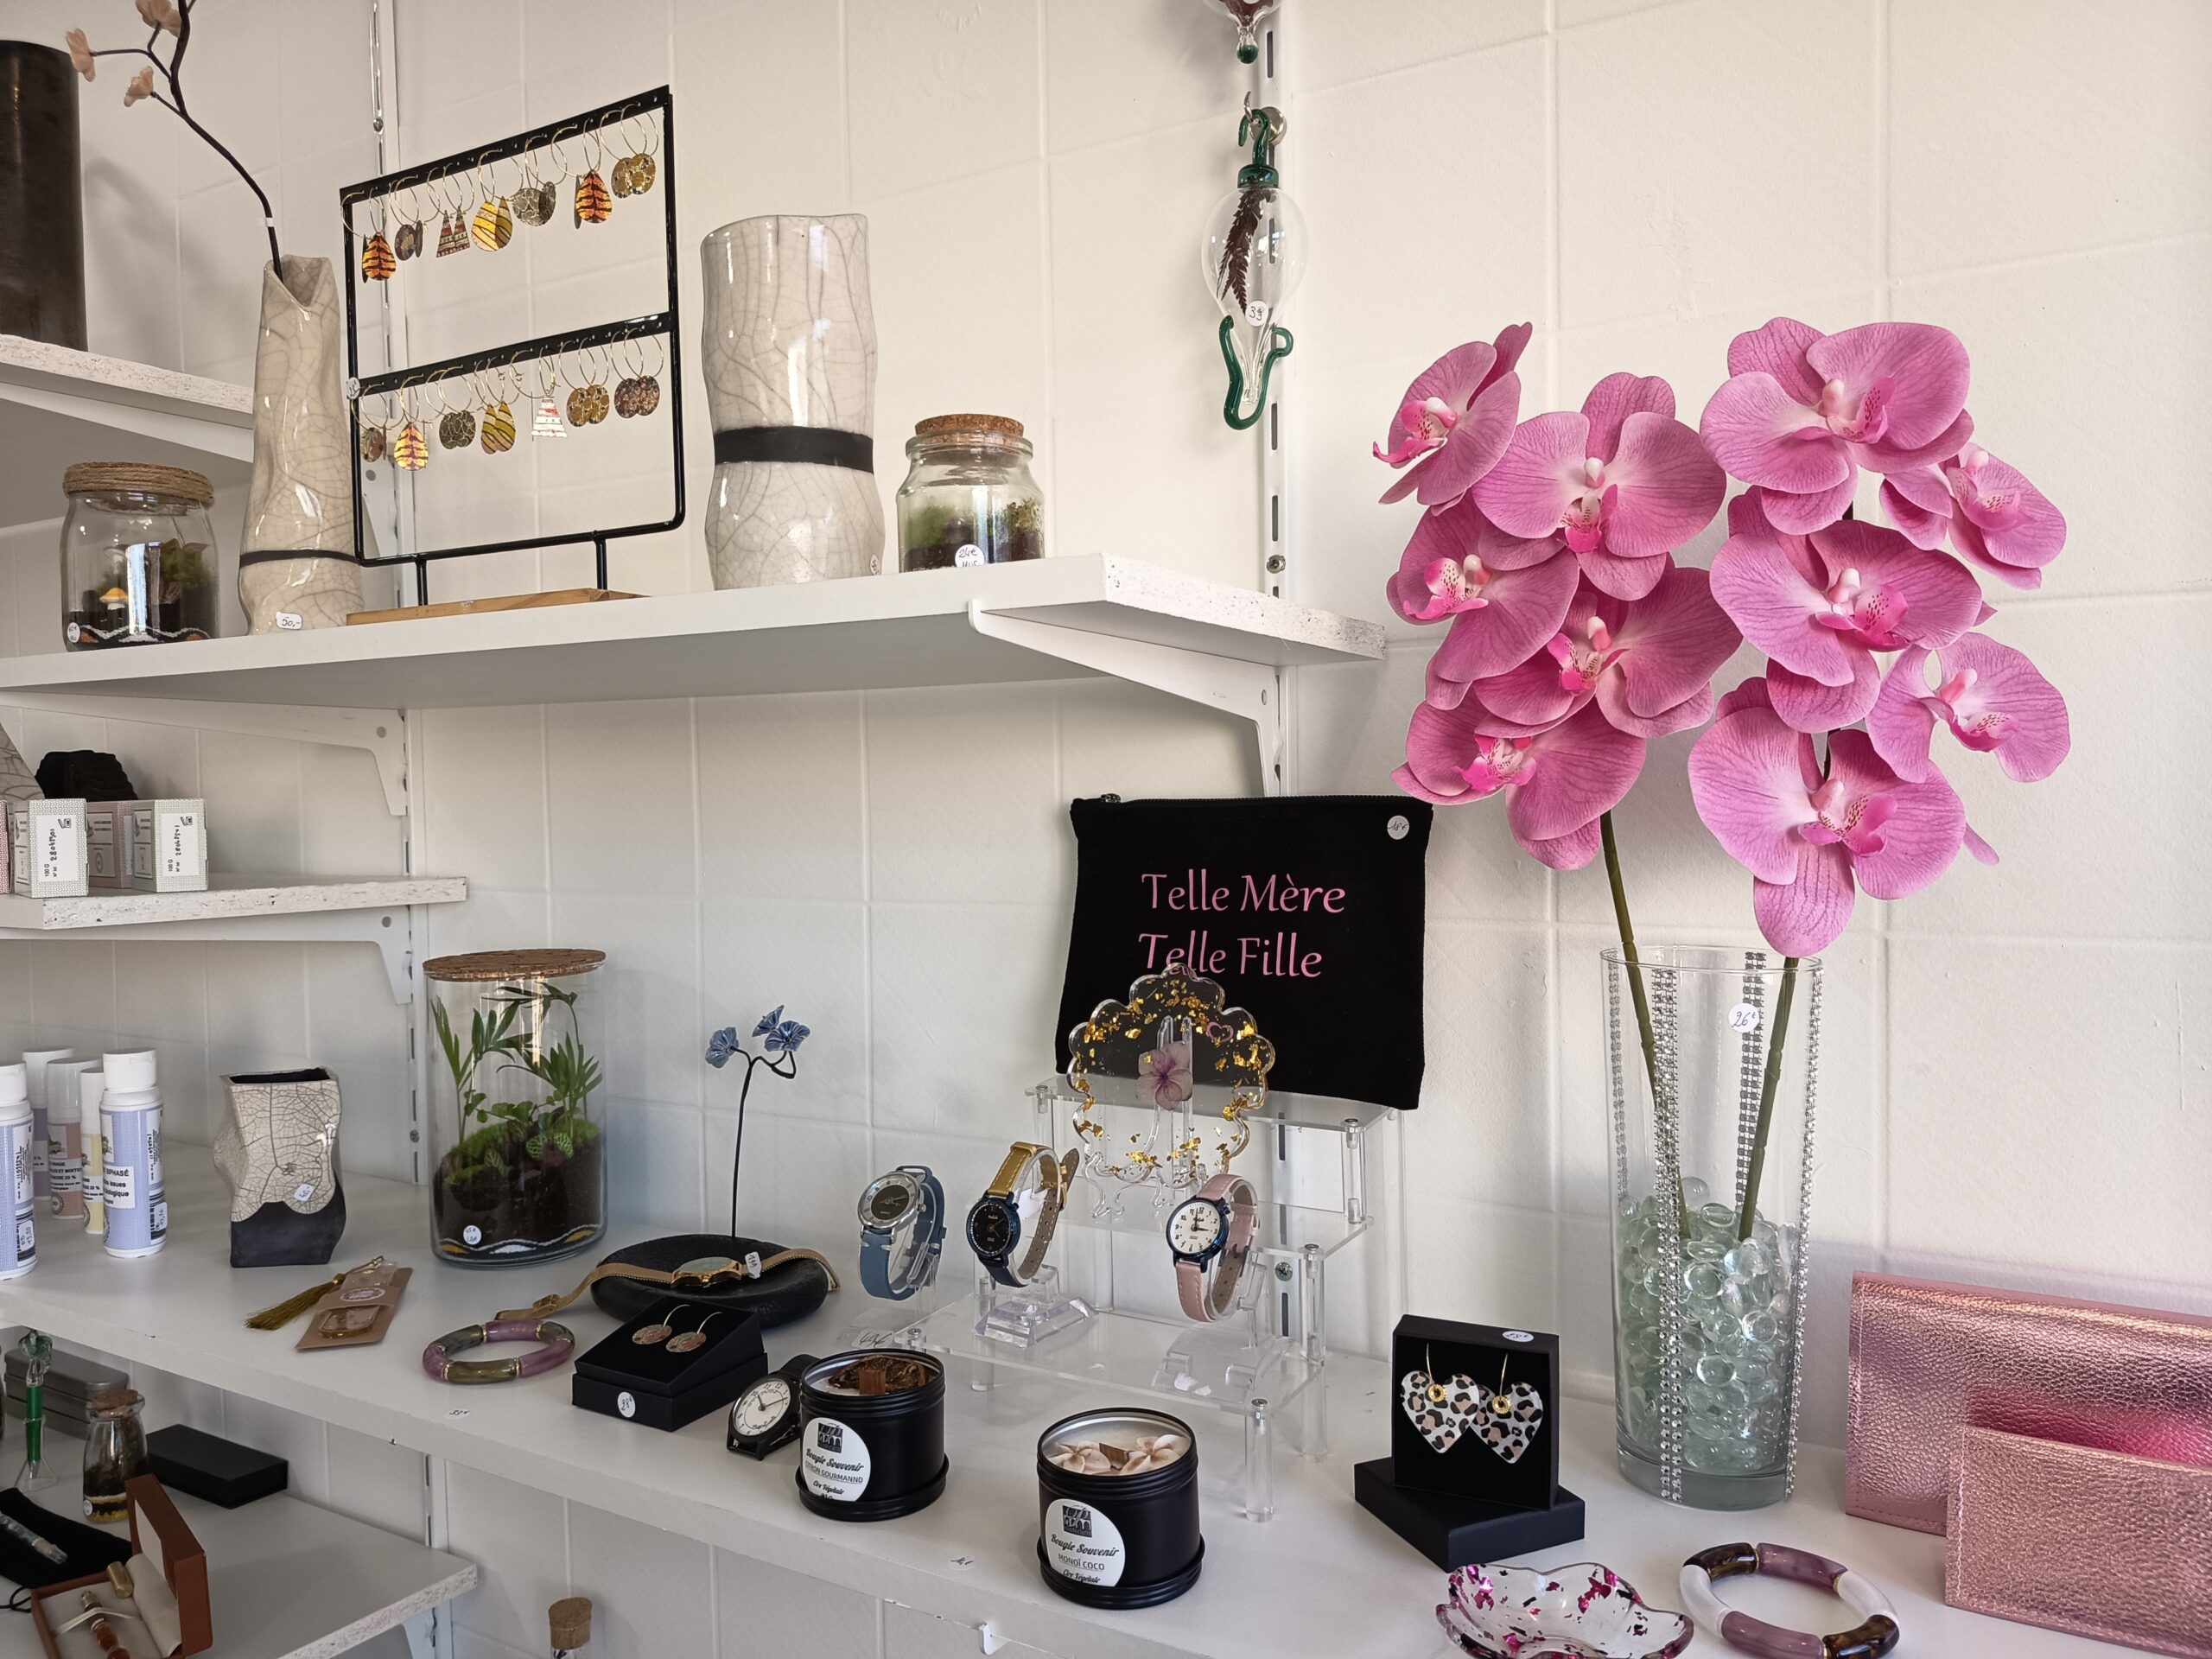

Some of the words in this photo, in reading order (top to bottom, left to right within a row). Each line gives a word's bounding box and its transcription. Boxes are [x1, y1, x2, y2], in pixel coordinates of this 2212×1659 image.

[1141, 868, 1230, 911] Telle
[1241, 874, 1346, 913] Mère
[1138, 930, 1227, 975] Telle
[1237, 931, 1323, 978] Fille
[806, 1448, 826, 1465] Bougie
[826, 1458, 864, 1471] Souvenir
[821, 1469, 864, 1484] GOURMANND
[1051, 1534, 1075, 1551] Bougie
[1077, 1543, 1119, 1557] Souvenir
[1058, 1553, 1082, 1567] MONOÏ
[1083, 1560, 1105, 1571] COCO
